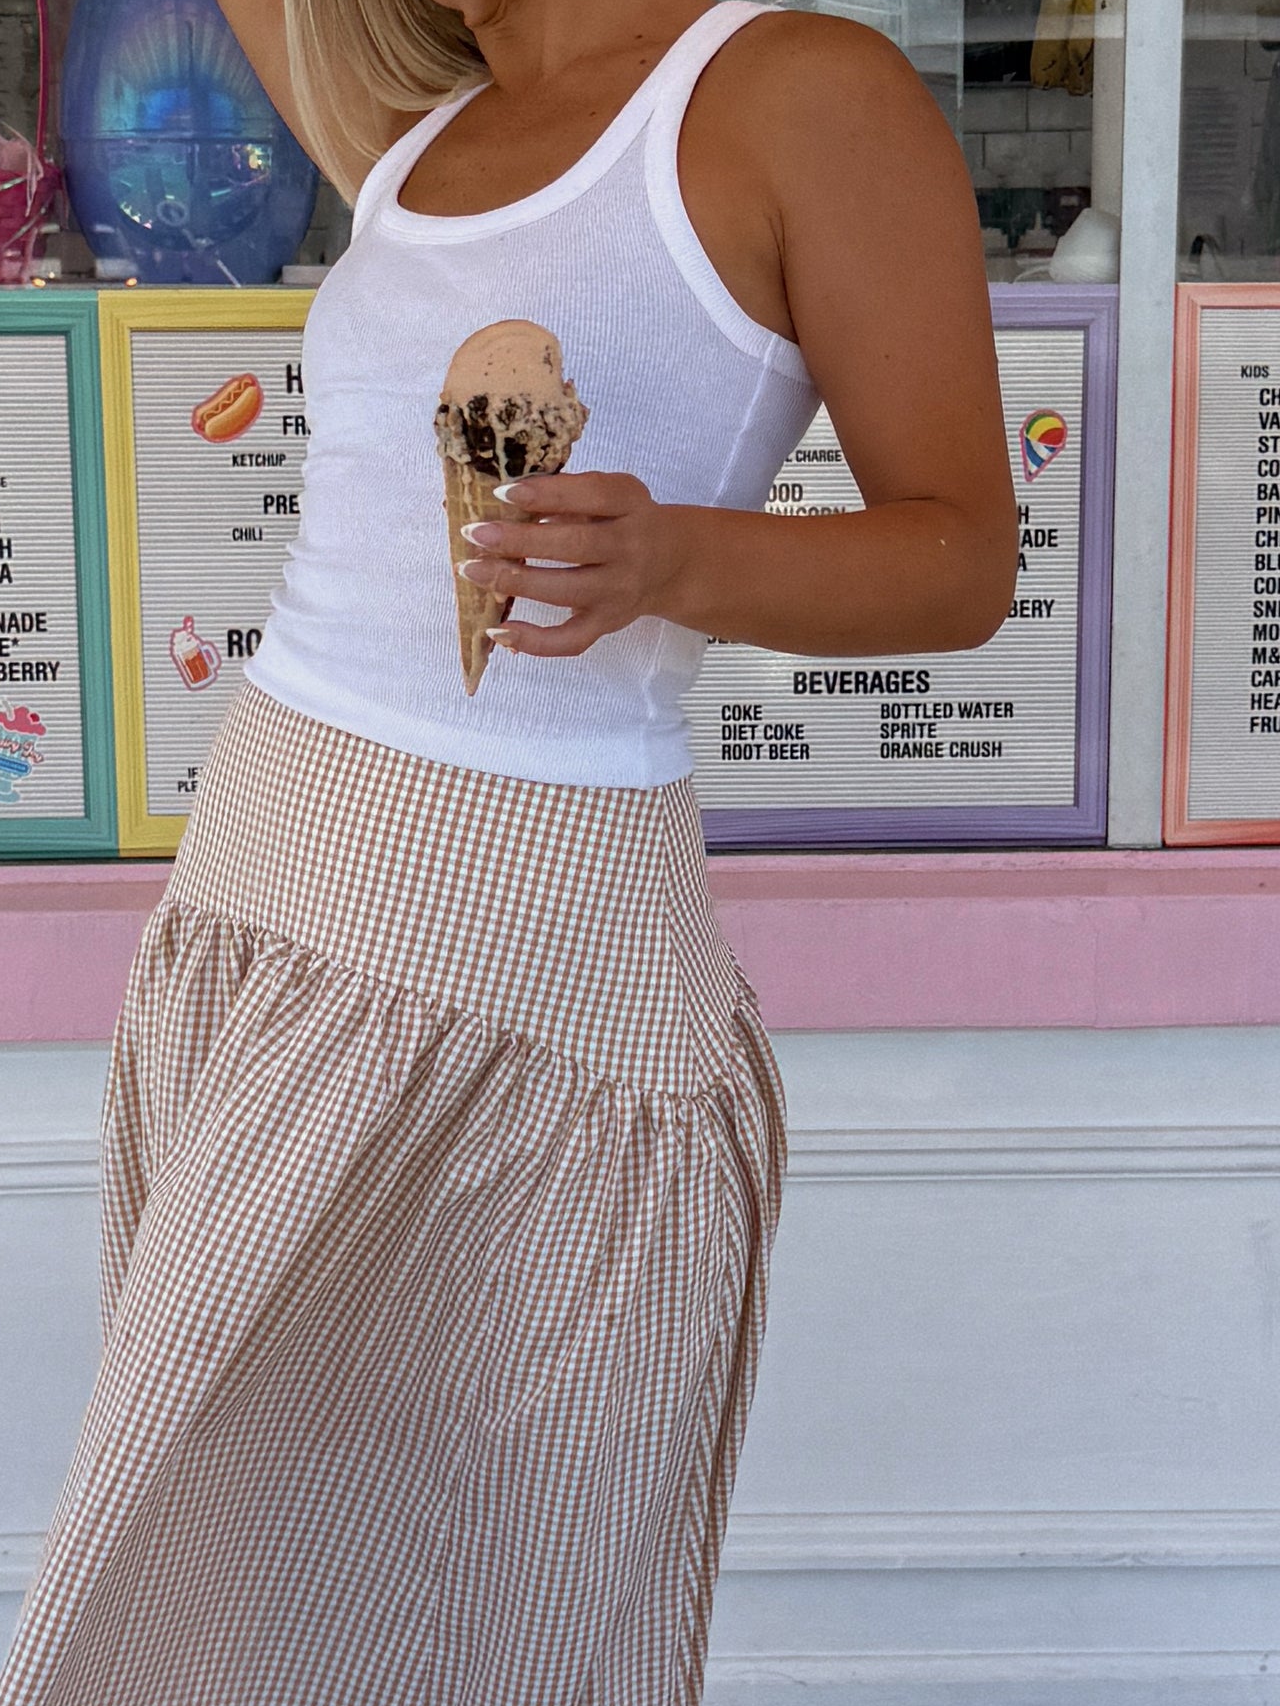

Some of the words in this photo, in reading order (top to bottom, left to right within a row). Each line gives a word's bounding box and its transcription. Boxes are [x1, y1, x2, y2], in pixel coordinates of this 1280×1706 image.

[232, 453, 286, 467] KETCHUP
[795, 449, 842, 462] CHARGE
[232, 527, 263, 541] CHILI
[793, 670, 931, 695] BEVERAGES
[721, 704, 763, 722] COKE
[880, 703, 953, 720] BOTTLED
[958, 701, 1014, 718] WATER
[721, 724, 758, 742] DIET
[764, 723, 805, 741] COKE
[880, 723, 937, 739] SPRITE
[721, 744, 764, 761] ROOT
[768, 743, 810, 760] BEER
[880, 742, 945, 759] ORANGE
[950, 741, 1003, 758] CRUSH
